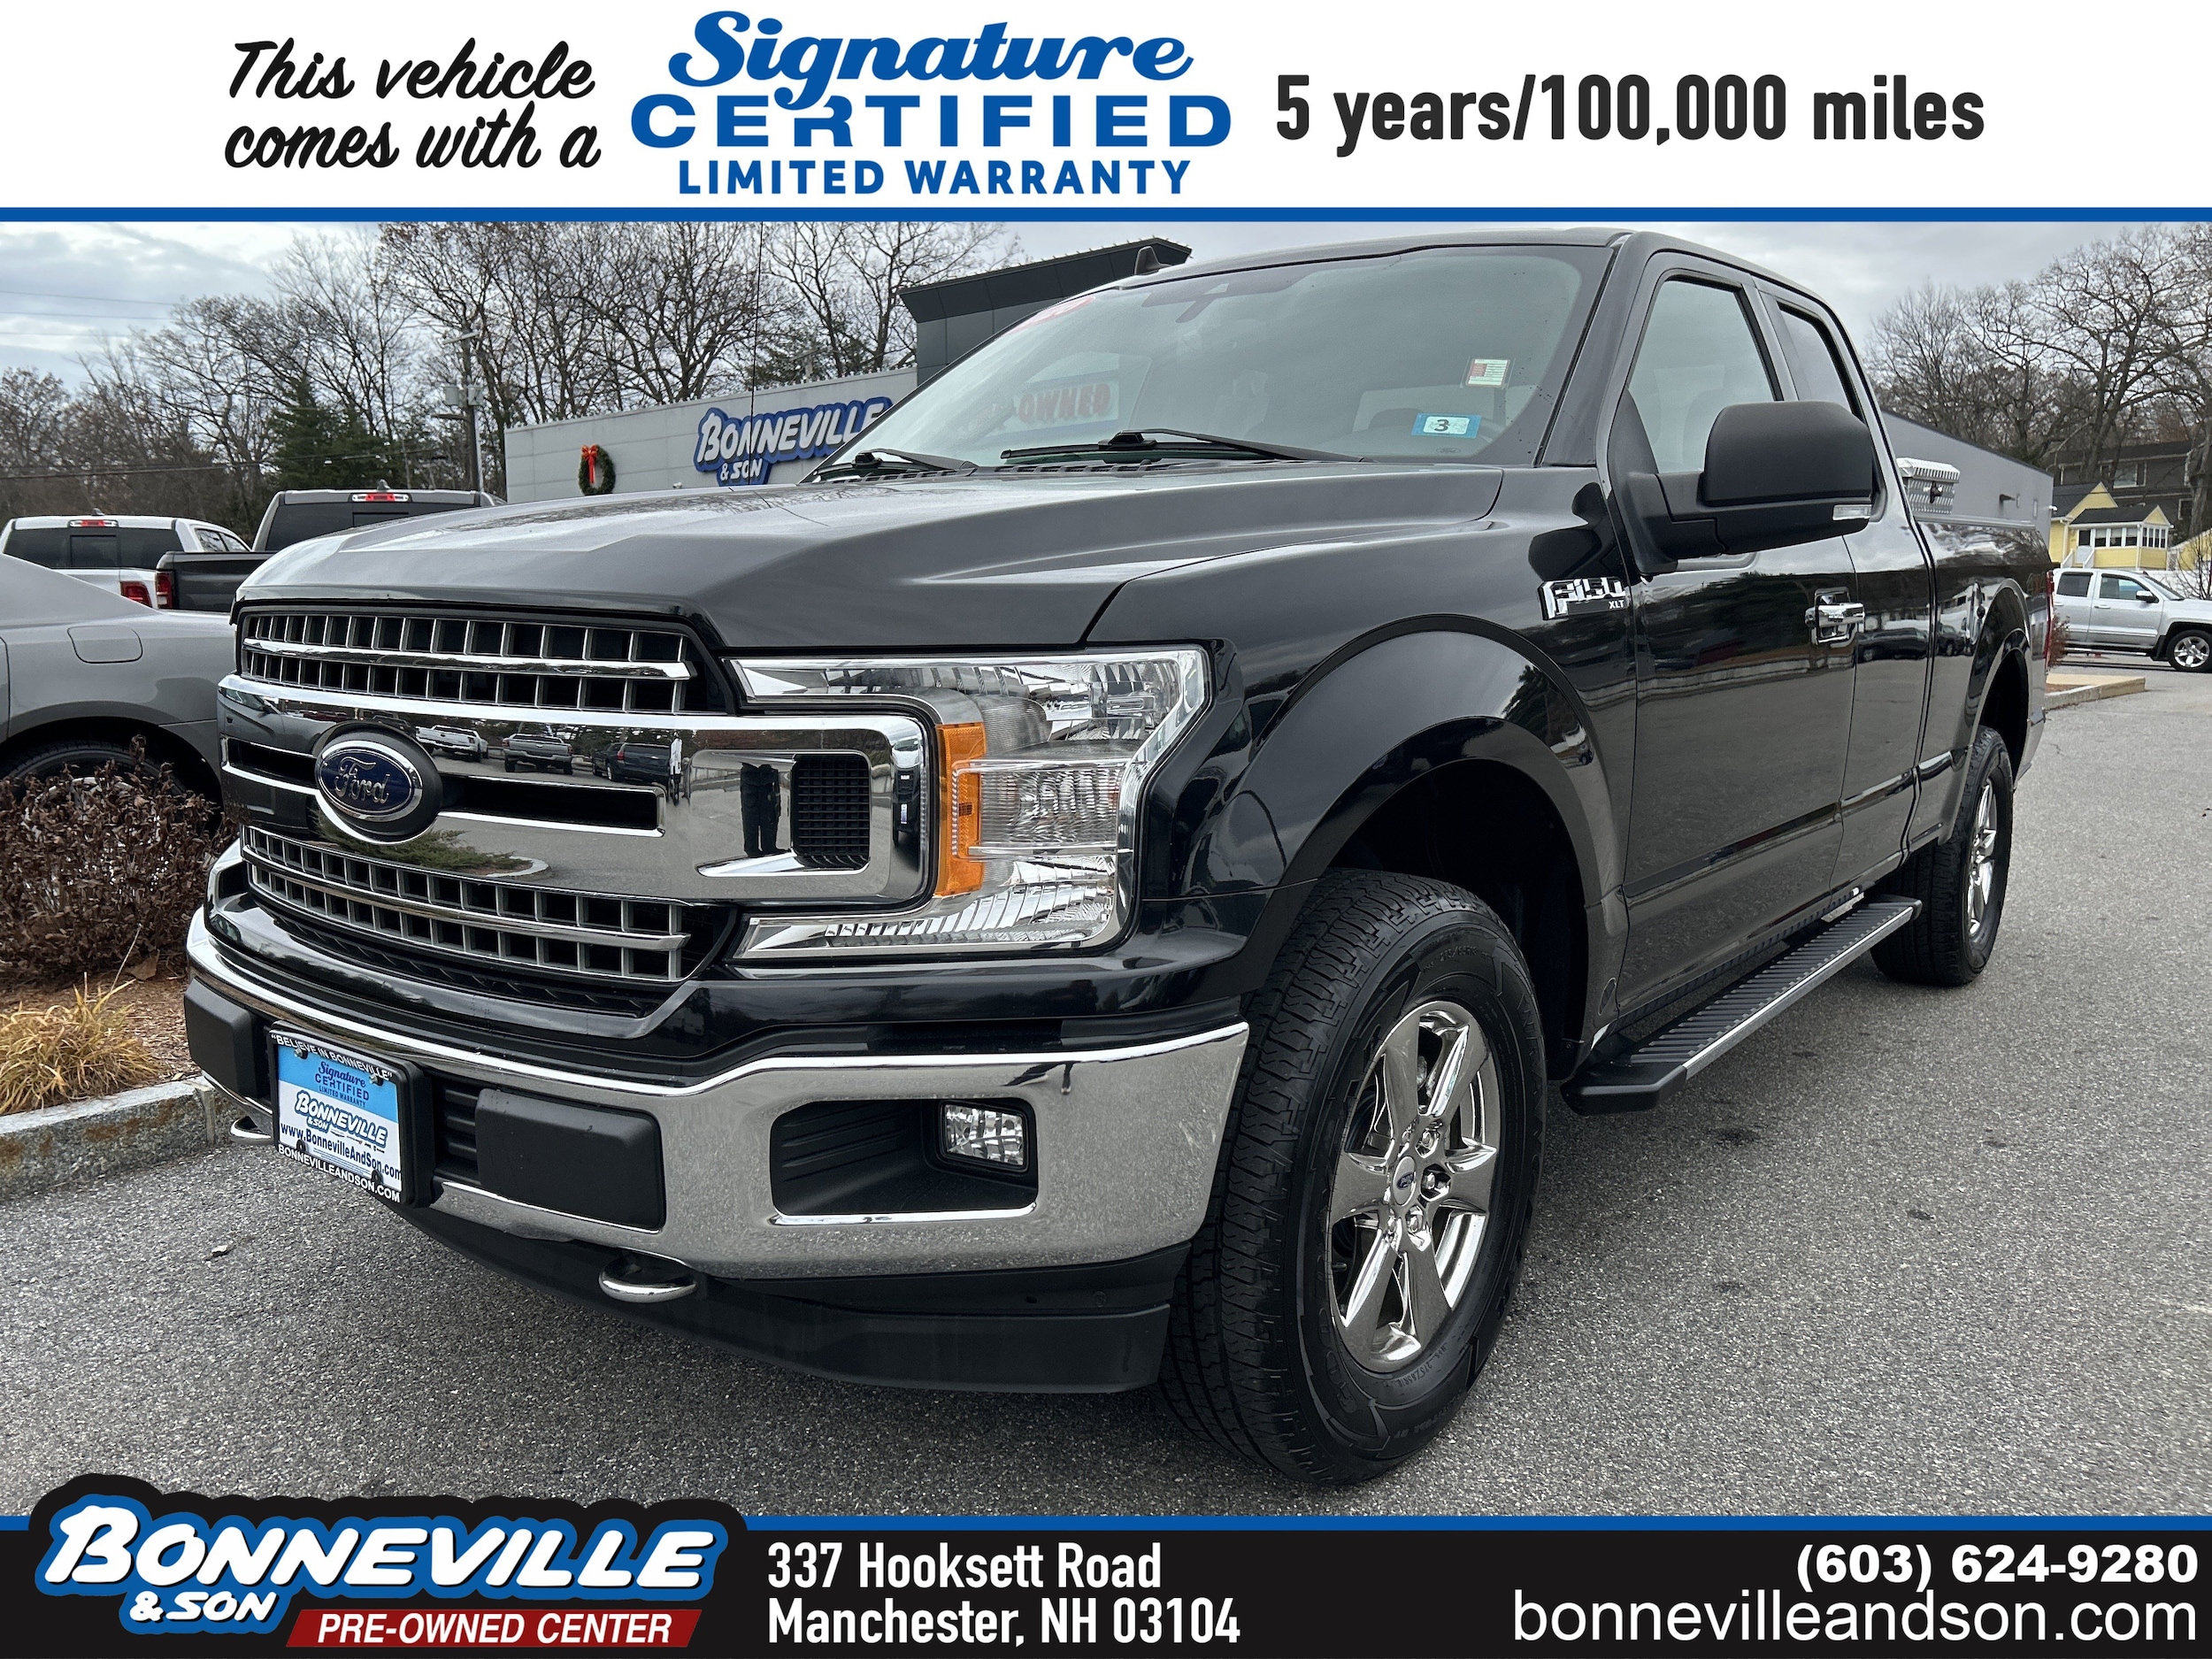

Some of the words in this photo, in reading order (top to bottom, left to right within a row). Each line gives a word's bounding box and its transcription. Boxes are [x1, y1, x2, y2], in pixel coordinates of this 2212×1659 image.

[1434, 419, 1450, 432] 3
[1609, 600, 1624, 609] XLT
[334, 757, 390, 803] Ford
[317, 1047, 328, 1057] IN
[315, 1073, 370, 1102] CERTIFIED
[318, 1062, 366, 1088] Signature
[319, 1085, 339, 1100] LIMITED
[339, 1092, 366, 1108] WARRANTY
[296, 1092, 387, 1146] BONNEVILLE
[278, 1144, 401, 1203] BONNEVILLEANDSON.COM
